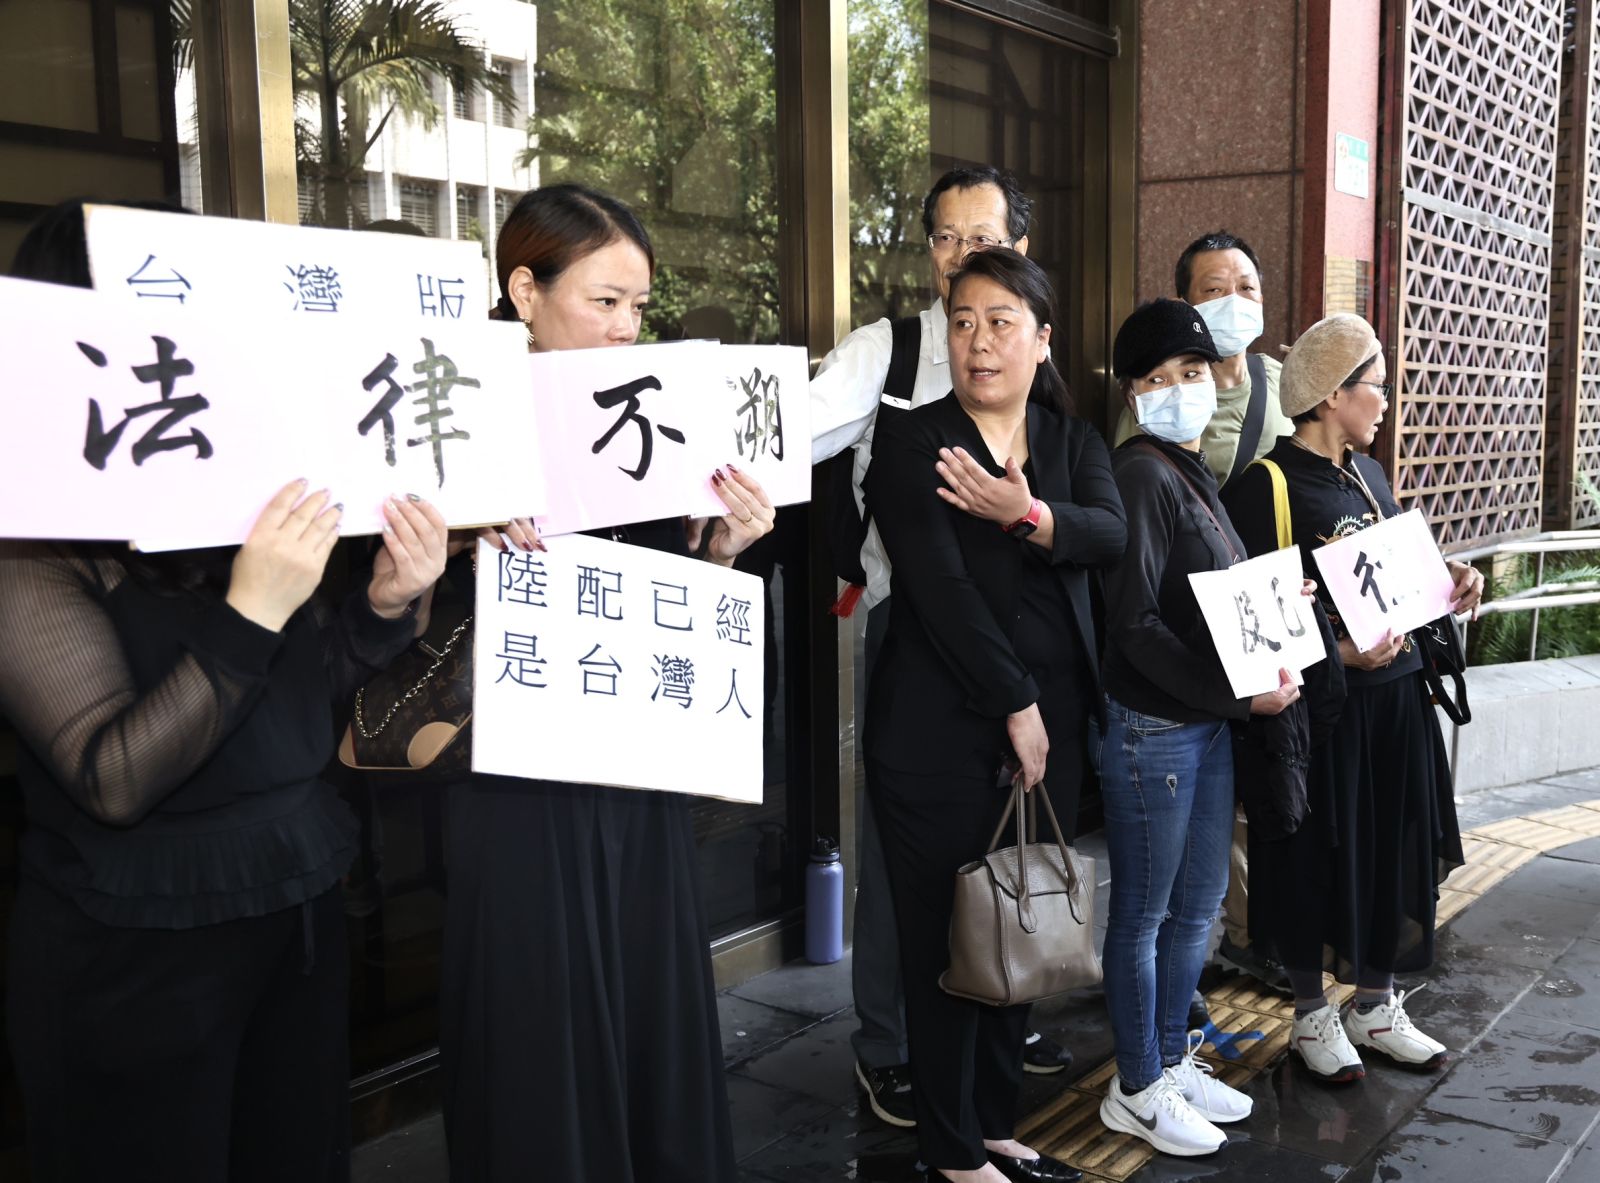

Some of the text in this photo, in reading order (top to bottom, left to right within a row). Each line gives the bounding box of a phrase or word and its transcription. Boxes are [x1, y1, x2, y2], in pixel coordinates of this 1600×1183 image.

[76, 335, 214, 471] 法
[357, 336, 481, 490] 律
[591, 374, 686, 482] 不
[497, 550, 753, 648] 陸配已經
[494, 630, 753, 720] 是台灣人
